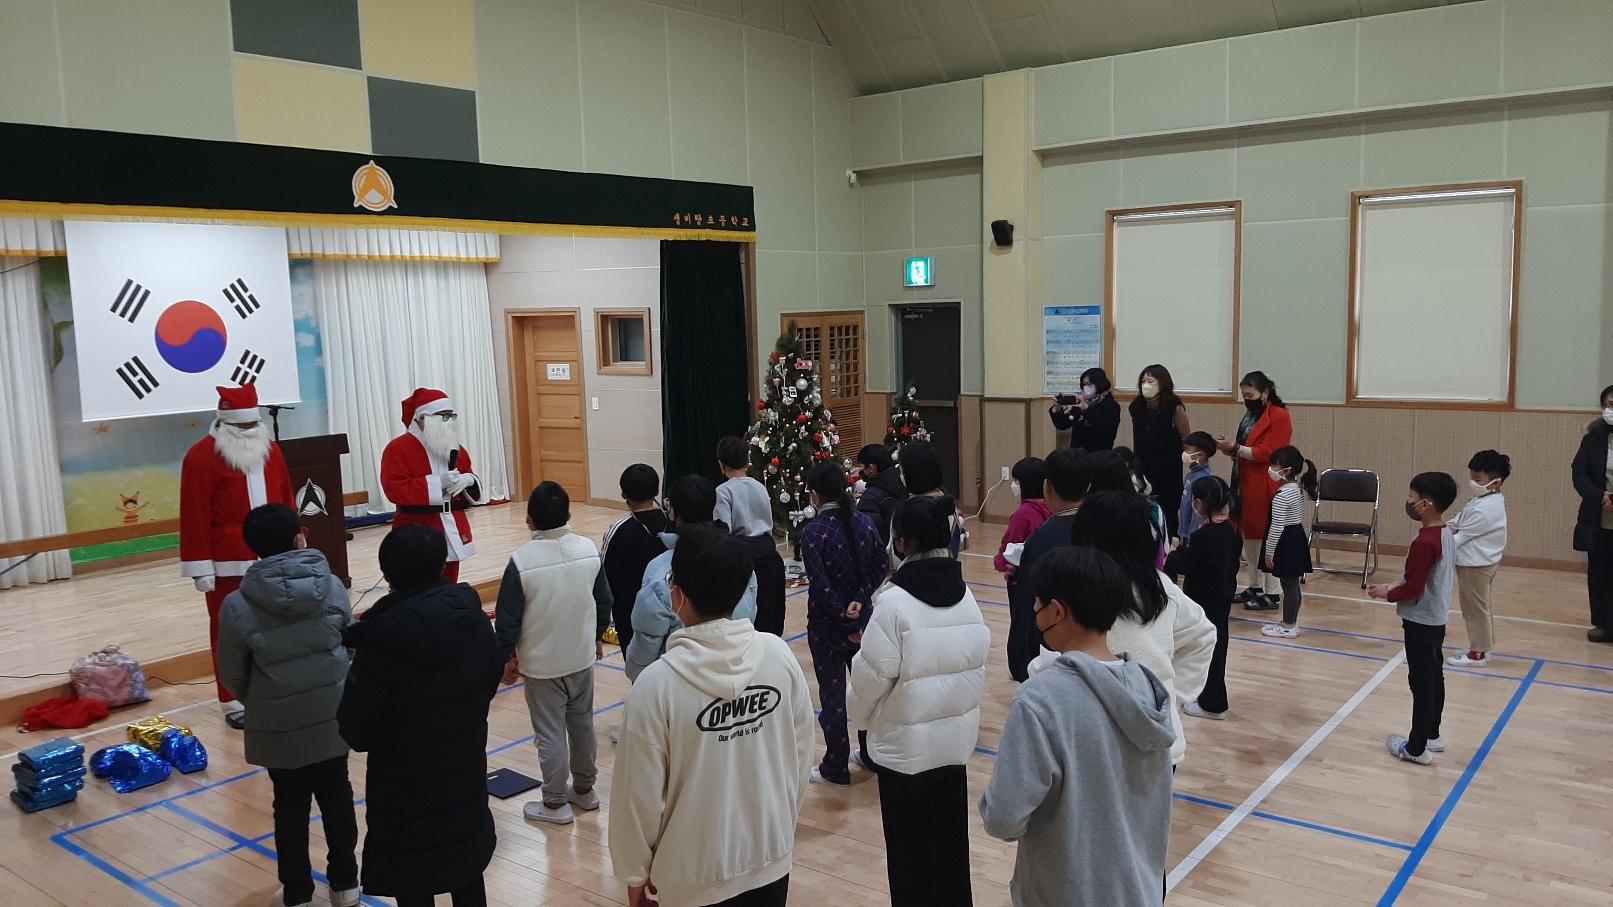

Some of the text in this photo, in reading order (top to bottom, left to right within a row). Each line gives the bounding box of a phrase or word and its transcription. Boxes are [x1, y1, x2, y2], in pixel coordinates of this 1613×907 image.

[708, 690, 771, 727] OPWEE
[718, 734, 729, 742] Our
[745, 727, 750, 736] is
